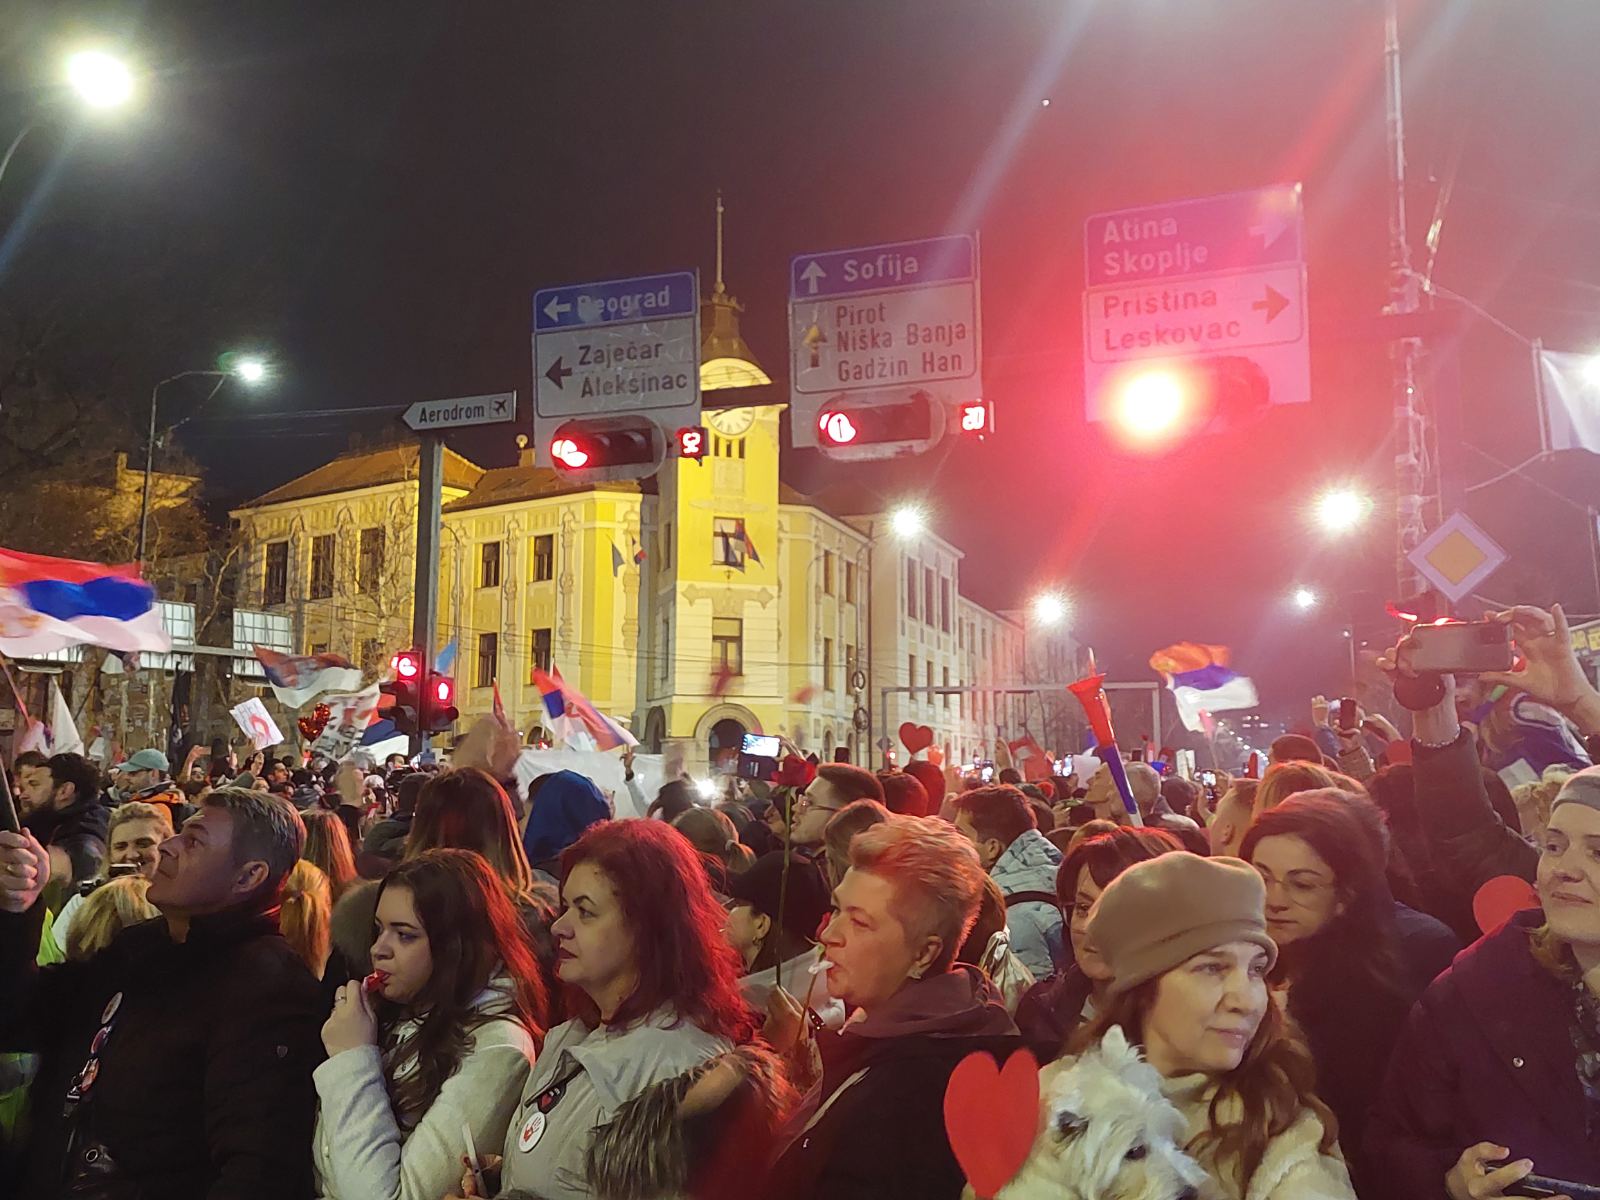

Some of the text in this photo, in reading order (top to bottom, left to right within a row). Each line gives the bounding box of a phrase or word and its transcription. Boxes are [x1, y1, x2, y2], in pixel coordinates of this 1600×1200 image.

[1103, 217, 1178, 244] Atina
[843, 254, 919, 282] Sofija
[1103, 241, 1209, 276] Skoplje
[836, 302, 886, 327] Pirot
[837, 321, 966, 353] Niška Banja
[1104, 320, 1241, 351] Leskovac
[578, 341, 663, 368] Zaječar
[838, 351, 962, 382] Gadžin Han
[581, 372, 688, 398] Aleksinac
[419, 403, 485, 424] Aerodrom
